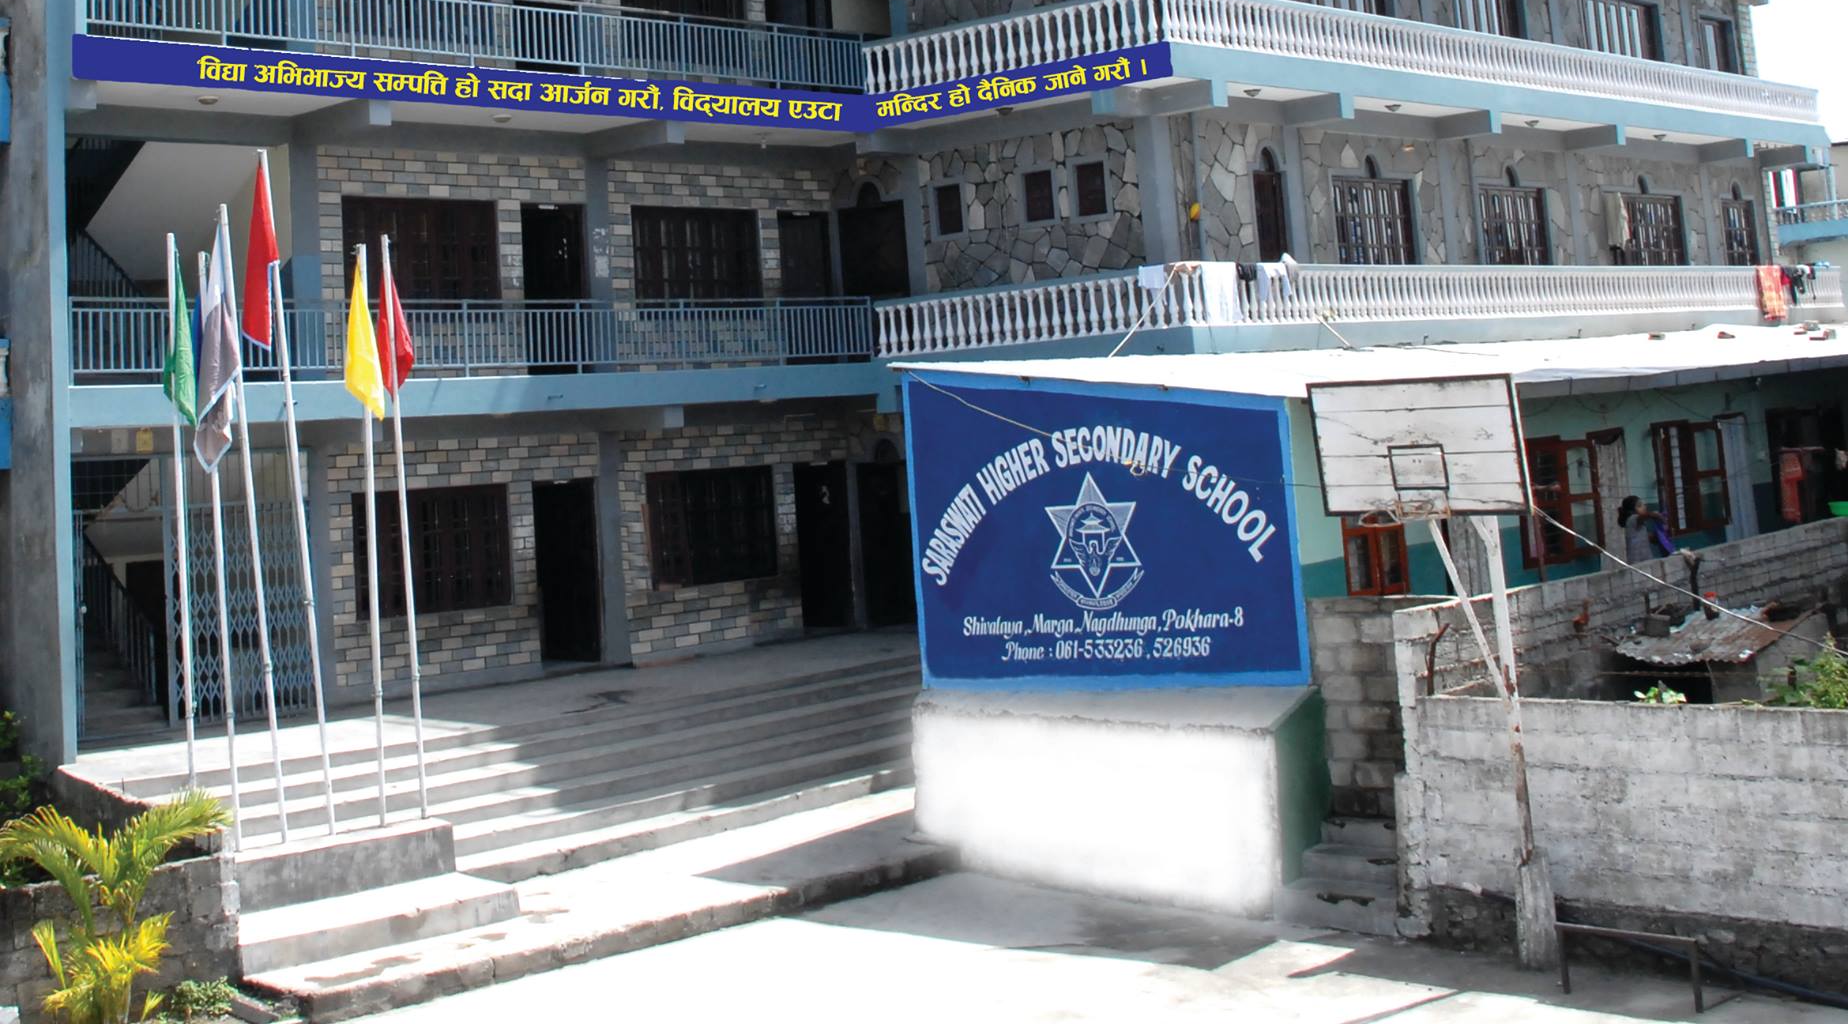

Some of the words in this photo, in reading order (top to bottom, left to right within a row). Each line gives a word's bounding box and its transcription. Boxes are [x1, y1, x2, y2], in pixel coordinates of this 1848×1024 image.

[197, 55, 248, 82] विद्या
[253, 60, 367, 90] अभिभाज्य
[373, 70, 449, 96] सम्पत्ति
[454, 72, 481, 99] हो
[487, 80, 533, 102] सदा
[539, 81, 612, 106] आर्जन
[788, 99, 843, 121] एउटा
[876, 92, 943, 117] मन्दिर
[949, 83, 971, 108] हो
[976, 76, 1037, 102] दैनिक
[1043, 64, 1087, 92] जाने
[921, 483, 987, 586] SARASWATI
[975, 438, 1051, 506] HIGHER
[1051, 425, 1182, 479] SECONDARY
[1181, 455, 1276, 563] SCHOOL
[1162, 605, 1245, 633] Pokhara-8
[1152, 635, 1212, 658] 526936
